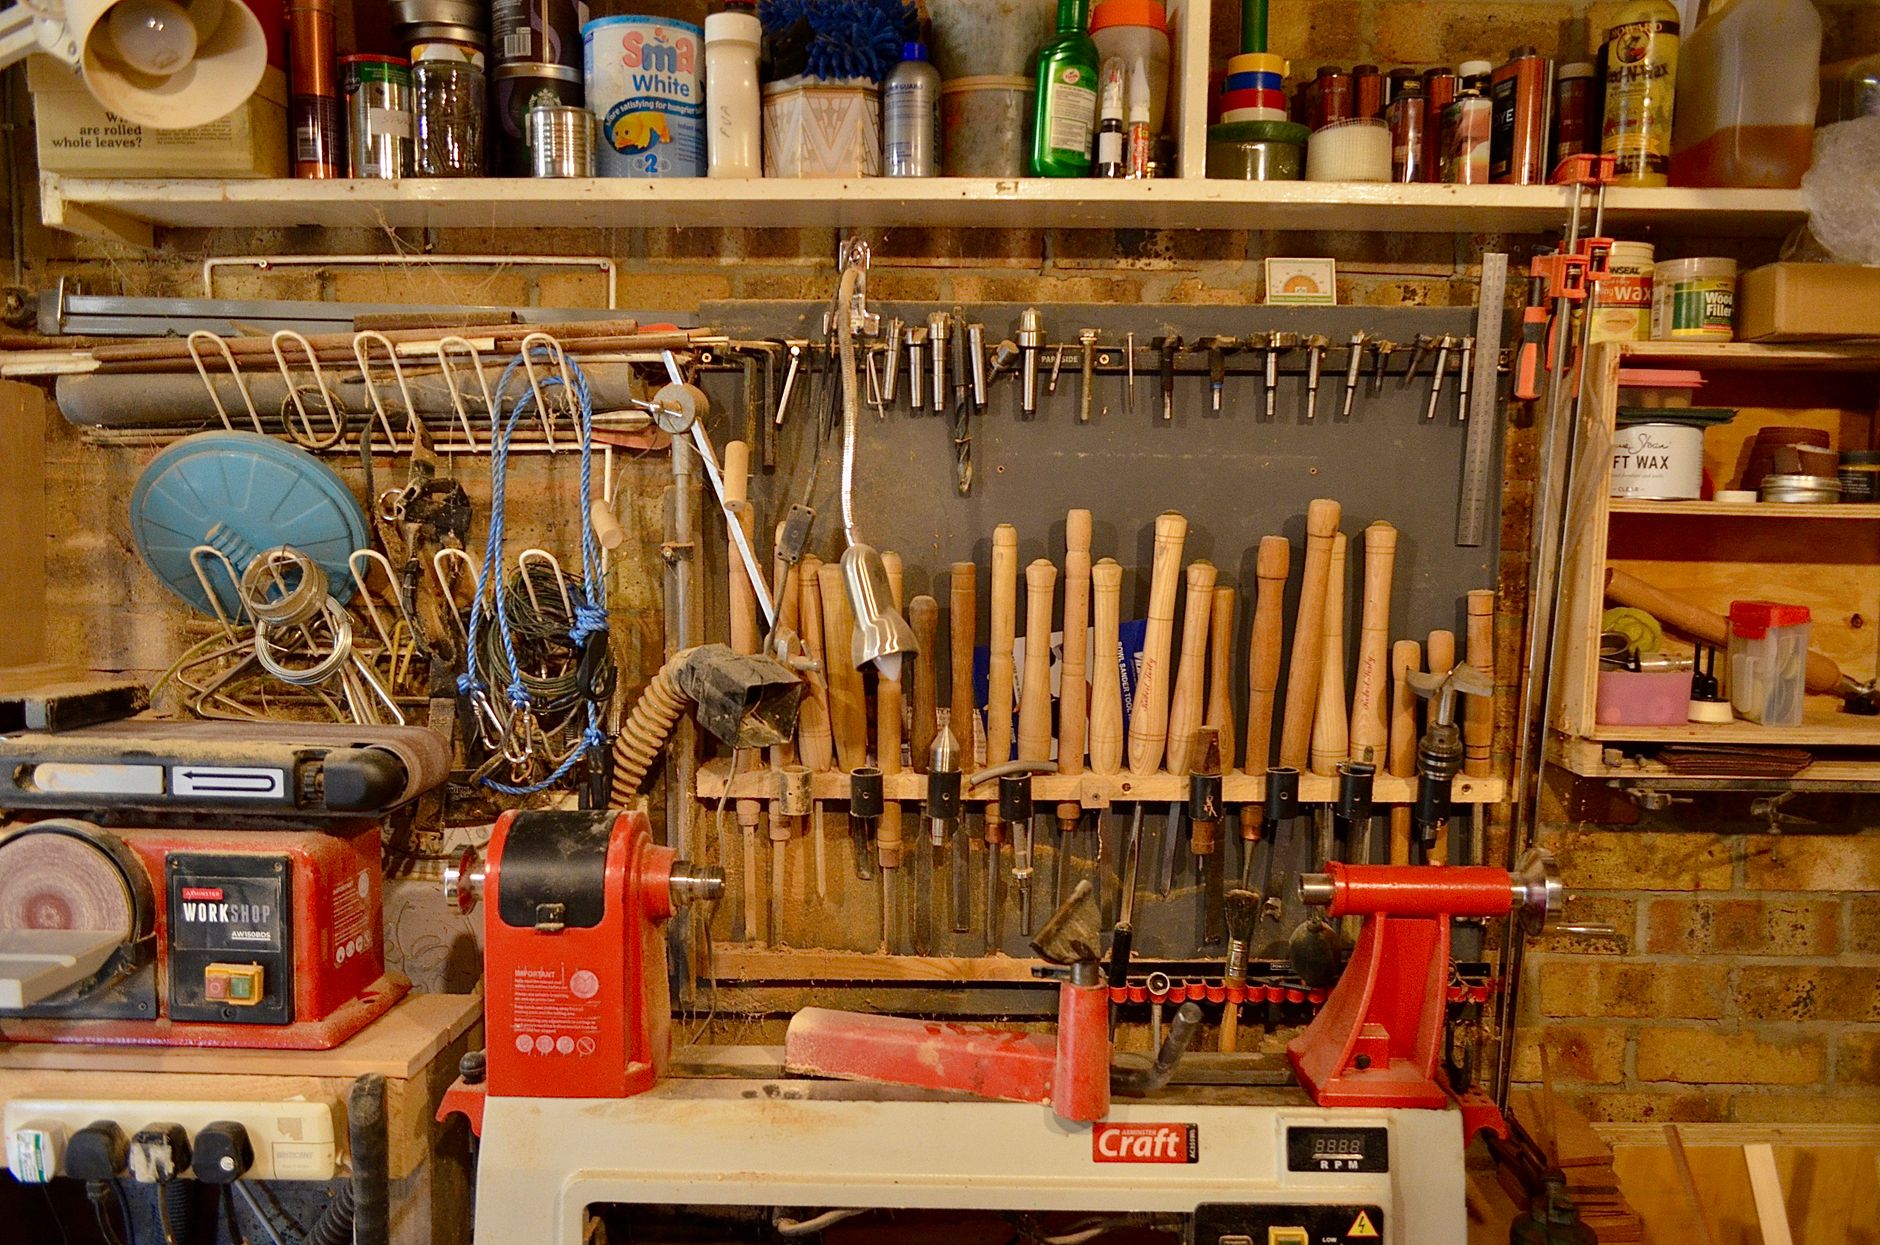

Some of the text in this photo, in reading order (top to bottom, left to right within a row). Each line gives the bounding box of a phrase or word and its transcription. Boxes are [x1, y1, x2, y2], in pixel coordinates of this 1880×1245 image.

[632, 74, 690, 97] White
[655, 100, 667, 110] for
[80, 125, 142, 136] are rolled
[52, 137, 143, 149] whole leaves?
[644, 153, 658, 173] 2
[1610, 266, 1641, 275] NSEAL
[1614, 286, 1651, 301] wax
[1705, 291, 1733, 305] Wood
[1706, 304, 1733, 317] Filler
[1041, 355, 1079, 363] PARSIDE
[1613, 455, 1669, 470] FT WAX
[183, 902, 271, 923] WORKSHOP
[1098, 1128, 1180, 1157] Craft
